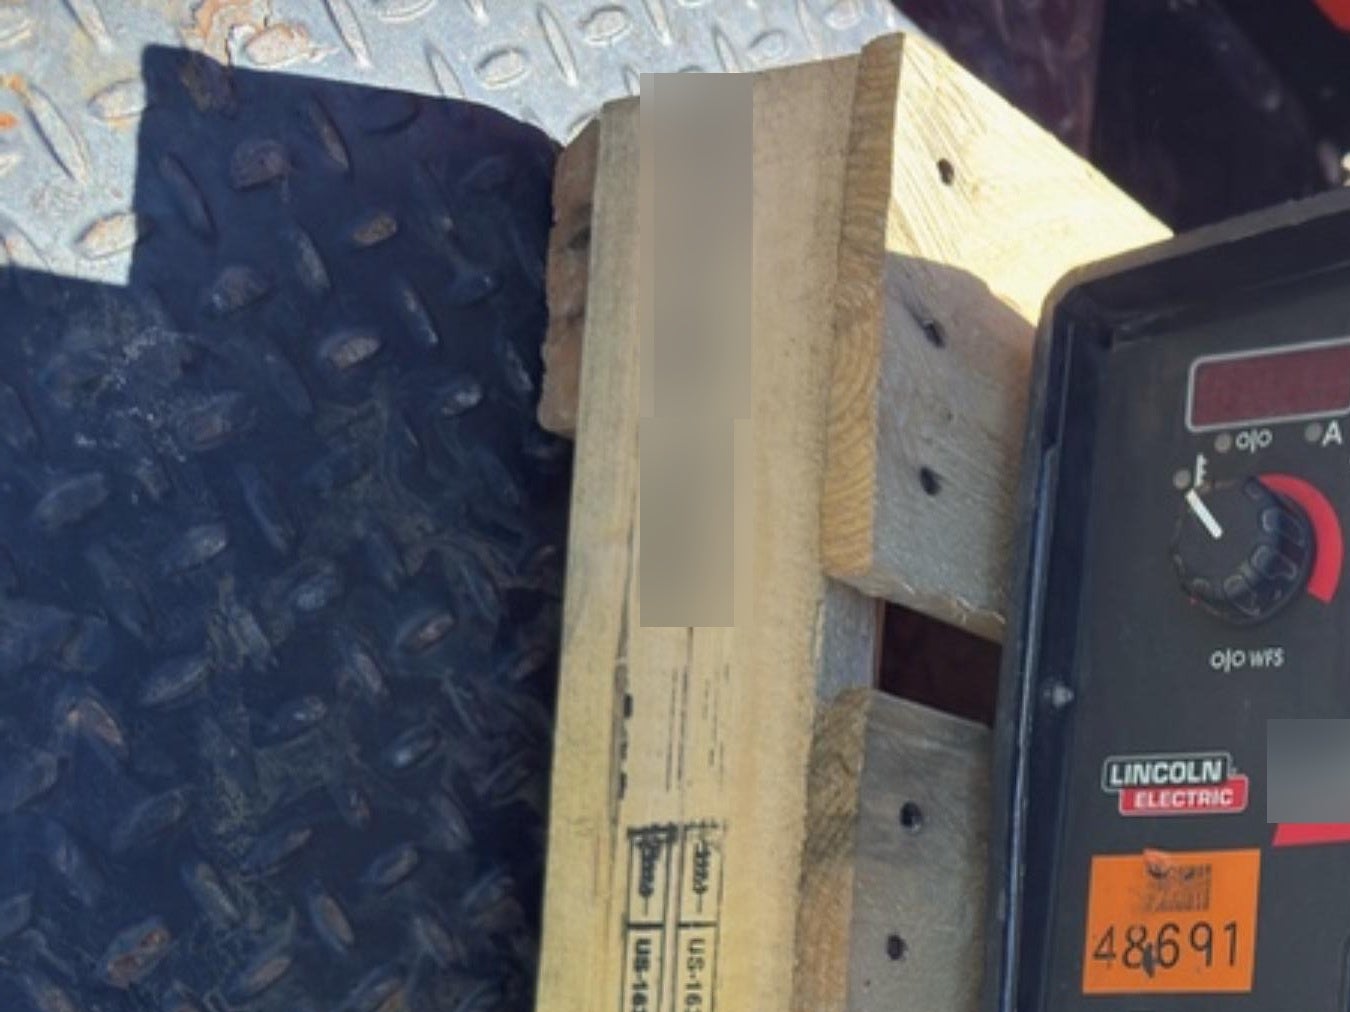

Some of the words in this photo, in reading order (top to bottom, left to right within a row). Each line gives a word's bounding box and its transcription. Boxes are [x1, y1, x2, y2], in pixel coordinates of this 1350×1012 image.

[1321, 420, 1342, 446] A
[1249, 647, 1284, 668] WFS
[1110, 759, 1222, 785] LINCOLN
[1133, 788, 1233, 808] ELECTRIC
[1092, 920, 1239, 969] 48691
